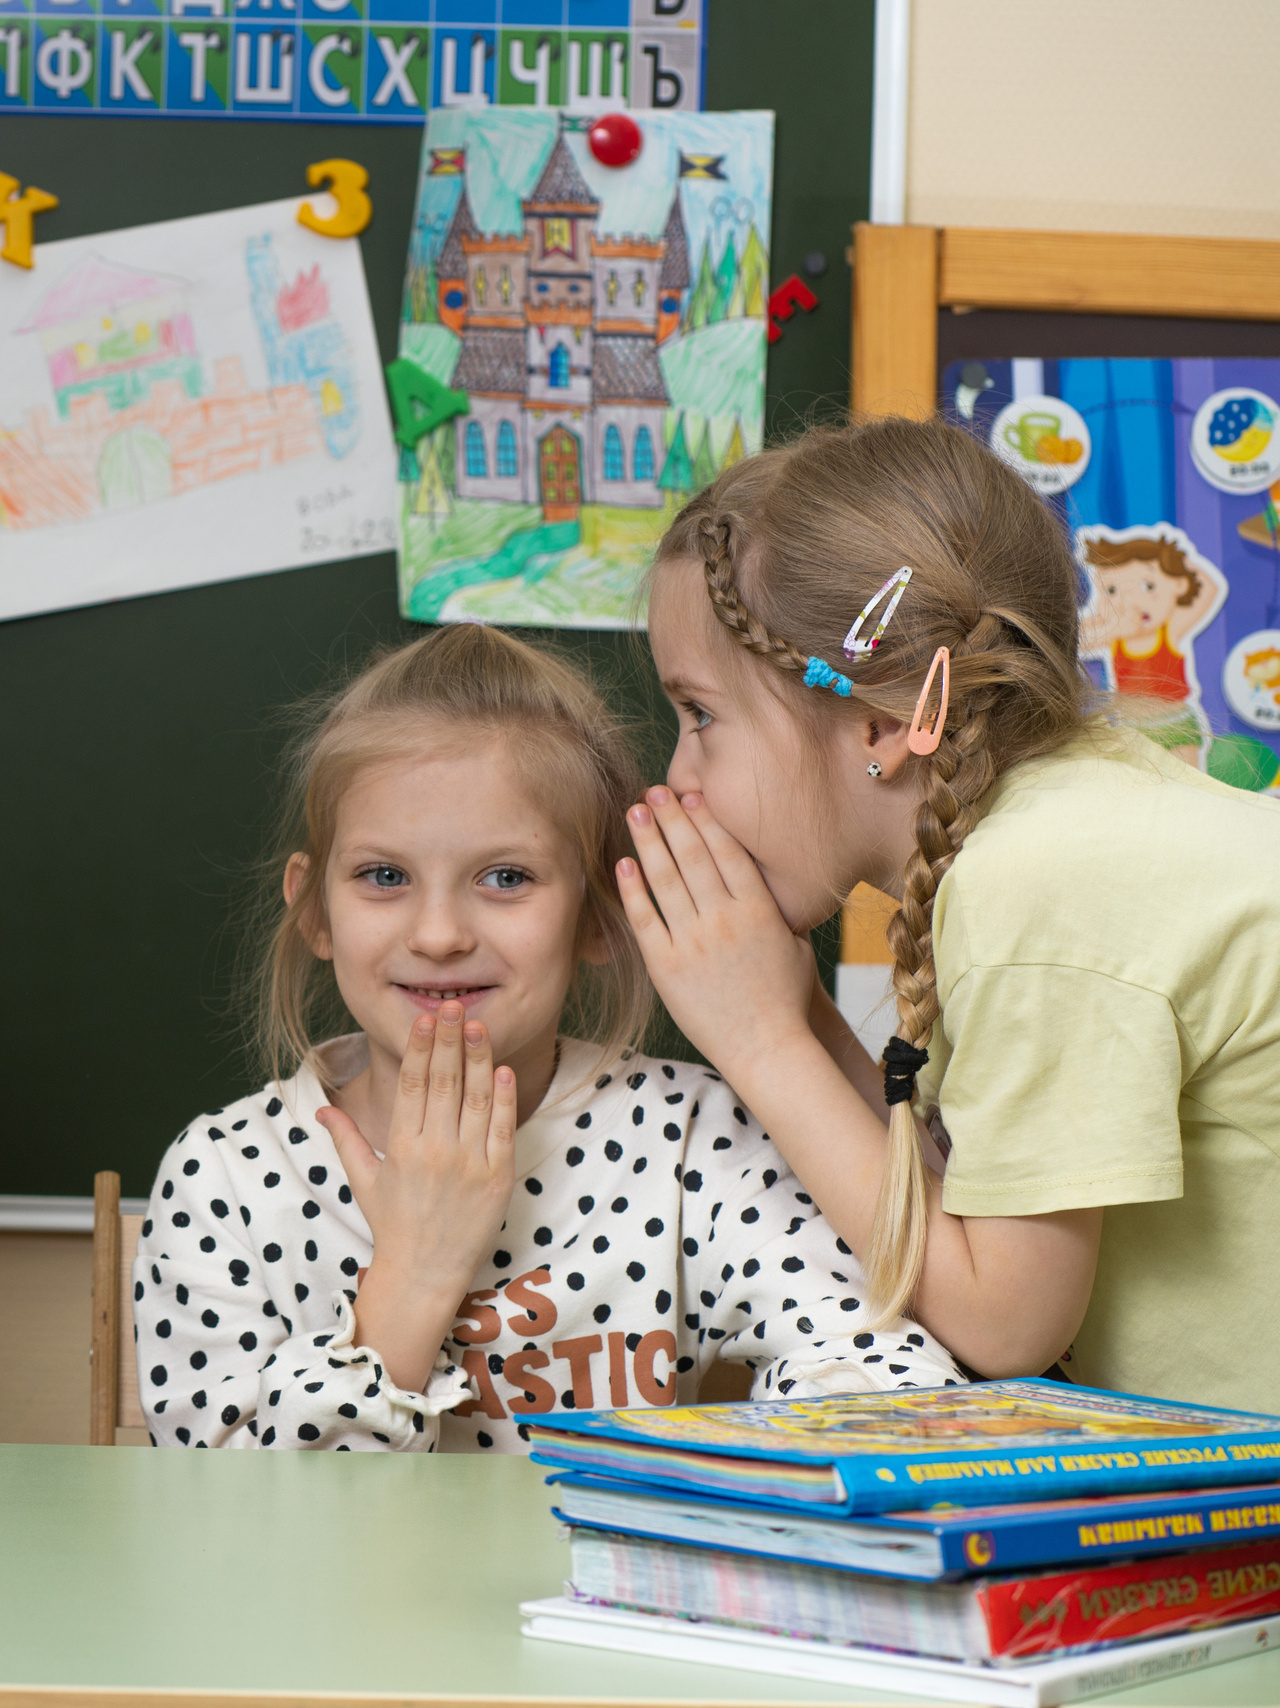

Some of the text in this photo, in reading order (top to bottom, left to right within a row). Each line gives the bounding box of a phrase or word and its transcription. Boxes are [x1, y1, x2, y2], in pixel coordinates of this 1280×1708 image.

[452, 1268, 558, 1345] SS
[453, 1329, 677, 1420] ASTIC
[906, 1459, 1015, 1484] МАЛЫШЕЙ
[1015, 1456, 1056, 1475] ДЛЯ
[1059, 1452, 1140, 1472] СКАЗКИ
[1140, 1446, 1228, 1466] РУССКИЕ
[1078, 1503, 1280, 1547] казки малышам
[1077, 1562, 1280, 1620] СКИЕ СКАЗКИ
